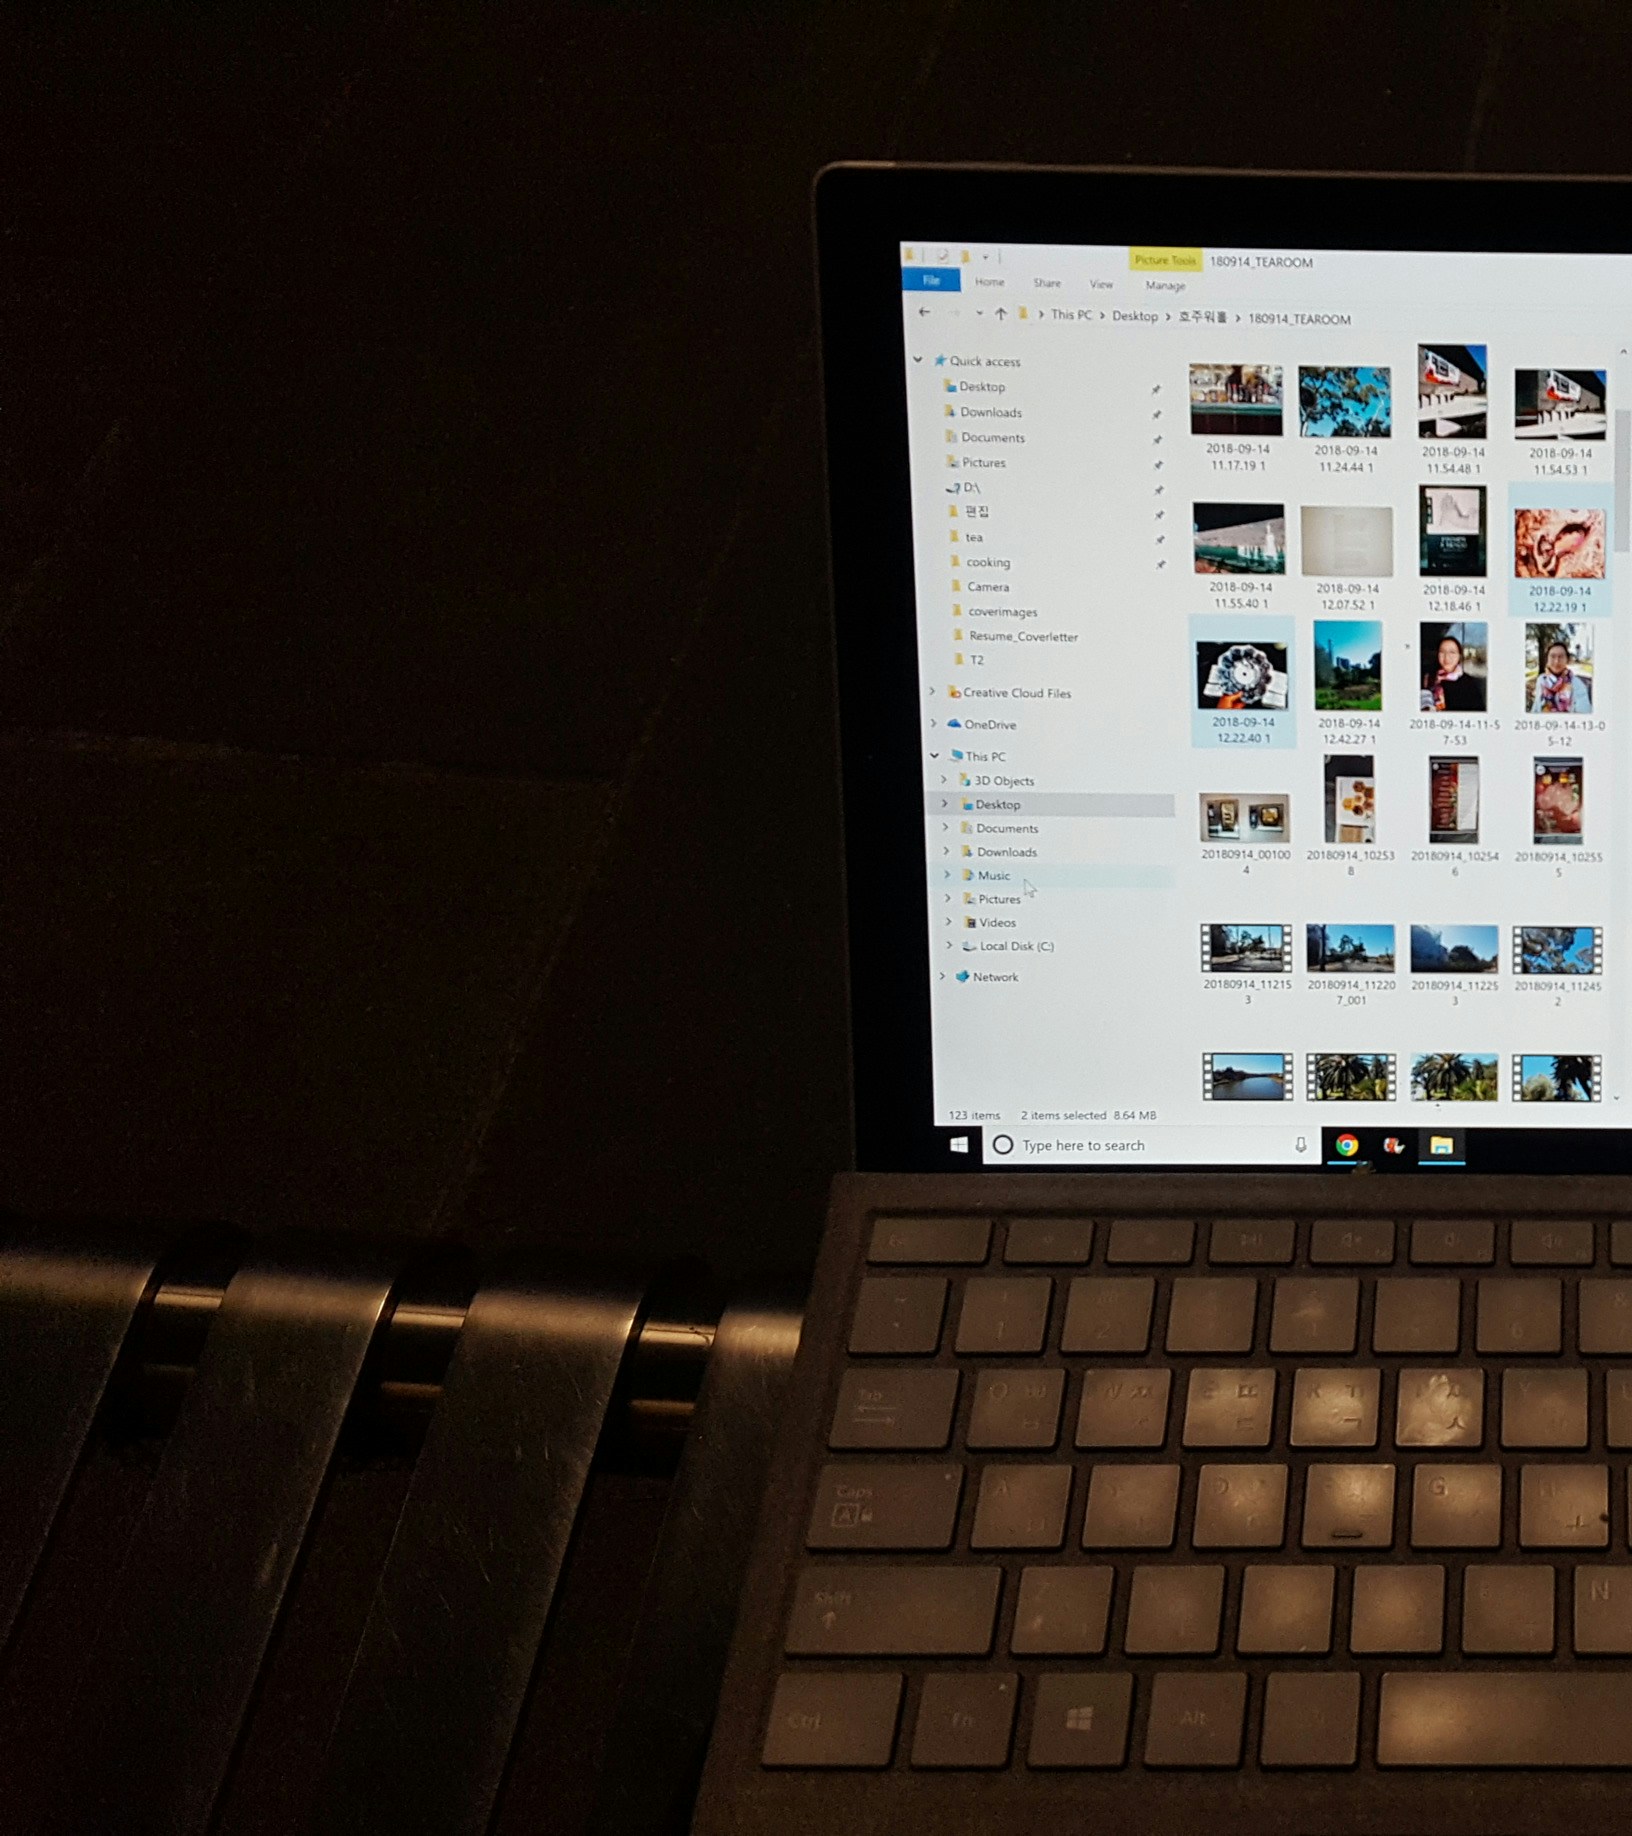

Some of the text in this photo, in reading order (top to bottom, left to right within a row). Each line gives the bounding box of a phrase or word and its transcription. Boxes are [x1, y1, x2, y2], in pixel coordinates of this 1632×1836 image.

[1210, 256, 1314, 269] 180914_TEAROOM
[923, 275, 940, 285] File
[974, 277, 1005, 287] Home
[1033, 278, 1062, 288] Share
[1089, 280, 1114, 289] View
[1145, 281, 1186, 293] Manage
[1050, 309, 1093, 320] This PC
[1112, 310, 1159, 324] Desktop
[1249, 313, 1352, 326] 180914_TEAROOM
[949, 356, 1022, 367] Quick access
[959, 381, 1006, 395] Desktop
[960, 407, 1023, 418] Downloads
[961, 432, 1026, 443] Documents
[1206, 443, 1271, 454] 2018-09-14
[1314, 445, 1378, 456] 2018-09-14
[1422, 446, 1486, 458] 2018-09-14
[1529, 448, 1593, 459] 2018-09-14
[962, 457, 1007, 467] Pictures
[1212, 460, 1257, 471] 11.17.19
[1319, 462, 1364, 472] 11.24.44
[1427, 464, 1472, 474] 11.54.48
[1534, 464, 1578, 475] 11.54.53
[965, 534, 984, 542] tea
[966, 557, 1011, 570] cooking
[967, 582, 1010, 592] Camera
[1209, 582, 1273, 592] 2018-09-14
[1316, 583, 1380, 594] 2018-09-14
[1423, 584, 1486, 595] 2018-09-14
[1529, 586, 1592, 596] 2018-09-14
[1215, 598, 1260, 609] 11.55.40
[1322, 600, 1366, 610] 12.07.52
[1428, 601, 1473, 611] 12.18.46
[1534, 602, 1578, 612] 12.22.19
[968, 608, 1038, 620] coverimages
[969, 631, 1079, 643] Resume_Coverletter
[970, 655, 985, 665] T2
[963, 687, 1072, 698] Creative Cloud Files
[964, 720, 1017, 730] OneDrive
[1212, 717, 1275, 727] 2018-09-14
[1318, 718, 1381, 728] 2018-09-14
[1409, 719, 1501, 730] 2018-09-14-11-5
[1514, 720, 1606, 731] 2018-09-14-13-0
[1217, 733, 1262, 743] 12.22.40
[1323, 734, 1367, 744] 12.42.27
[1443, 735, 1468, 745] 7-53
[1547, 736, 1573, 746] 5-12
[965, 752, 1007, 762] This PC
[975, 776, 1035, 789] 3D Objects
[975, 800, 1022, 812] Desktop
[976, 823, 1040, 833] Documents
[977, 847, 1038, 857] Downloads
[1201, 849, 1292, 861] 20180914_00100
[1306, 850, 1396, 862] 20180914_10253
[1410, 851, 1500, 863] 20180914_10254
[1514, 852, 1604, 863] 20180914_10255
[1242, 866, 1250, 874] 4
[1347, 866, 1355, 875] 8
[1451, 867, 1459, 876] 6
[1555, 868, 1563, 878] 5
[978, 871, 1011, 880] Music
[978, 894, 1022, 904] Pictures
[979, 918, 1017, 927] Videos
[980, 942, 1008, 951] Local
[1010, 942, 1035, 951] Disk
[973, 973, 1020, 982] Network
[1203, 979, 1293, 991] 20180914_11215
[1307, 980, 1397, 991] 20180914_11220
[1411, 980, 1500, 992] 20180914_11225
[1514, 981, 1603, 993] 20180914_11245
[1245, 995, 1252, 1004] 3
[1336, 995, 1367, 1006] 7_001
[1452, 996, 1459, 1006] 3
[1554, 997, 1562, 1006] 2
[948, 1111, 1001, 1120] 123 items
[1020, 1110, 1158, 1120] 2 items selected 8.64 MB
[1022, 1139, 1146, 1154] Type here to search
[1590, 1581, 1610, 1602] N
